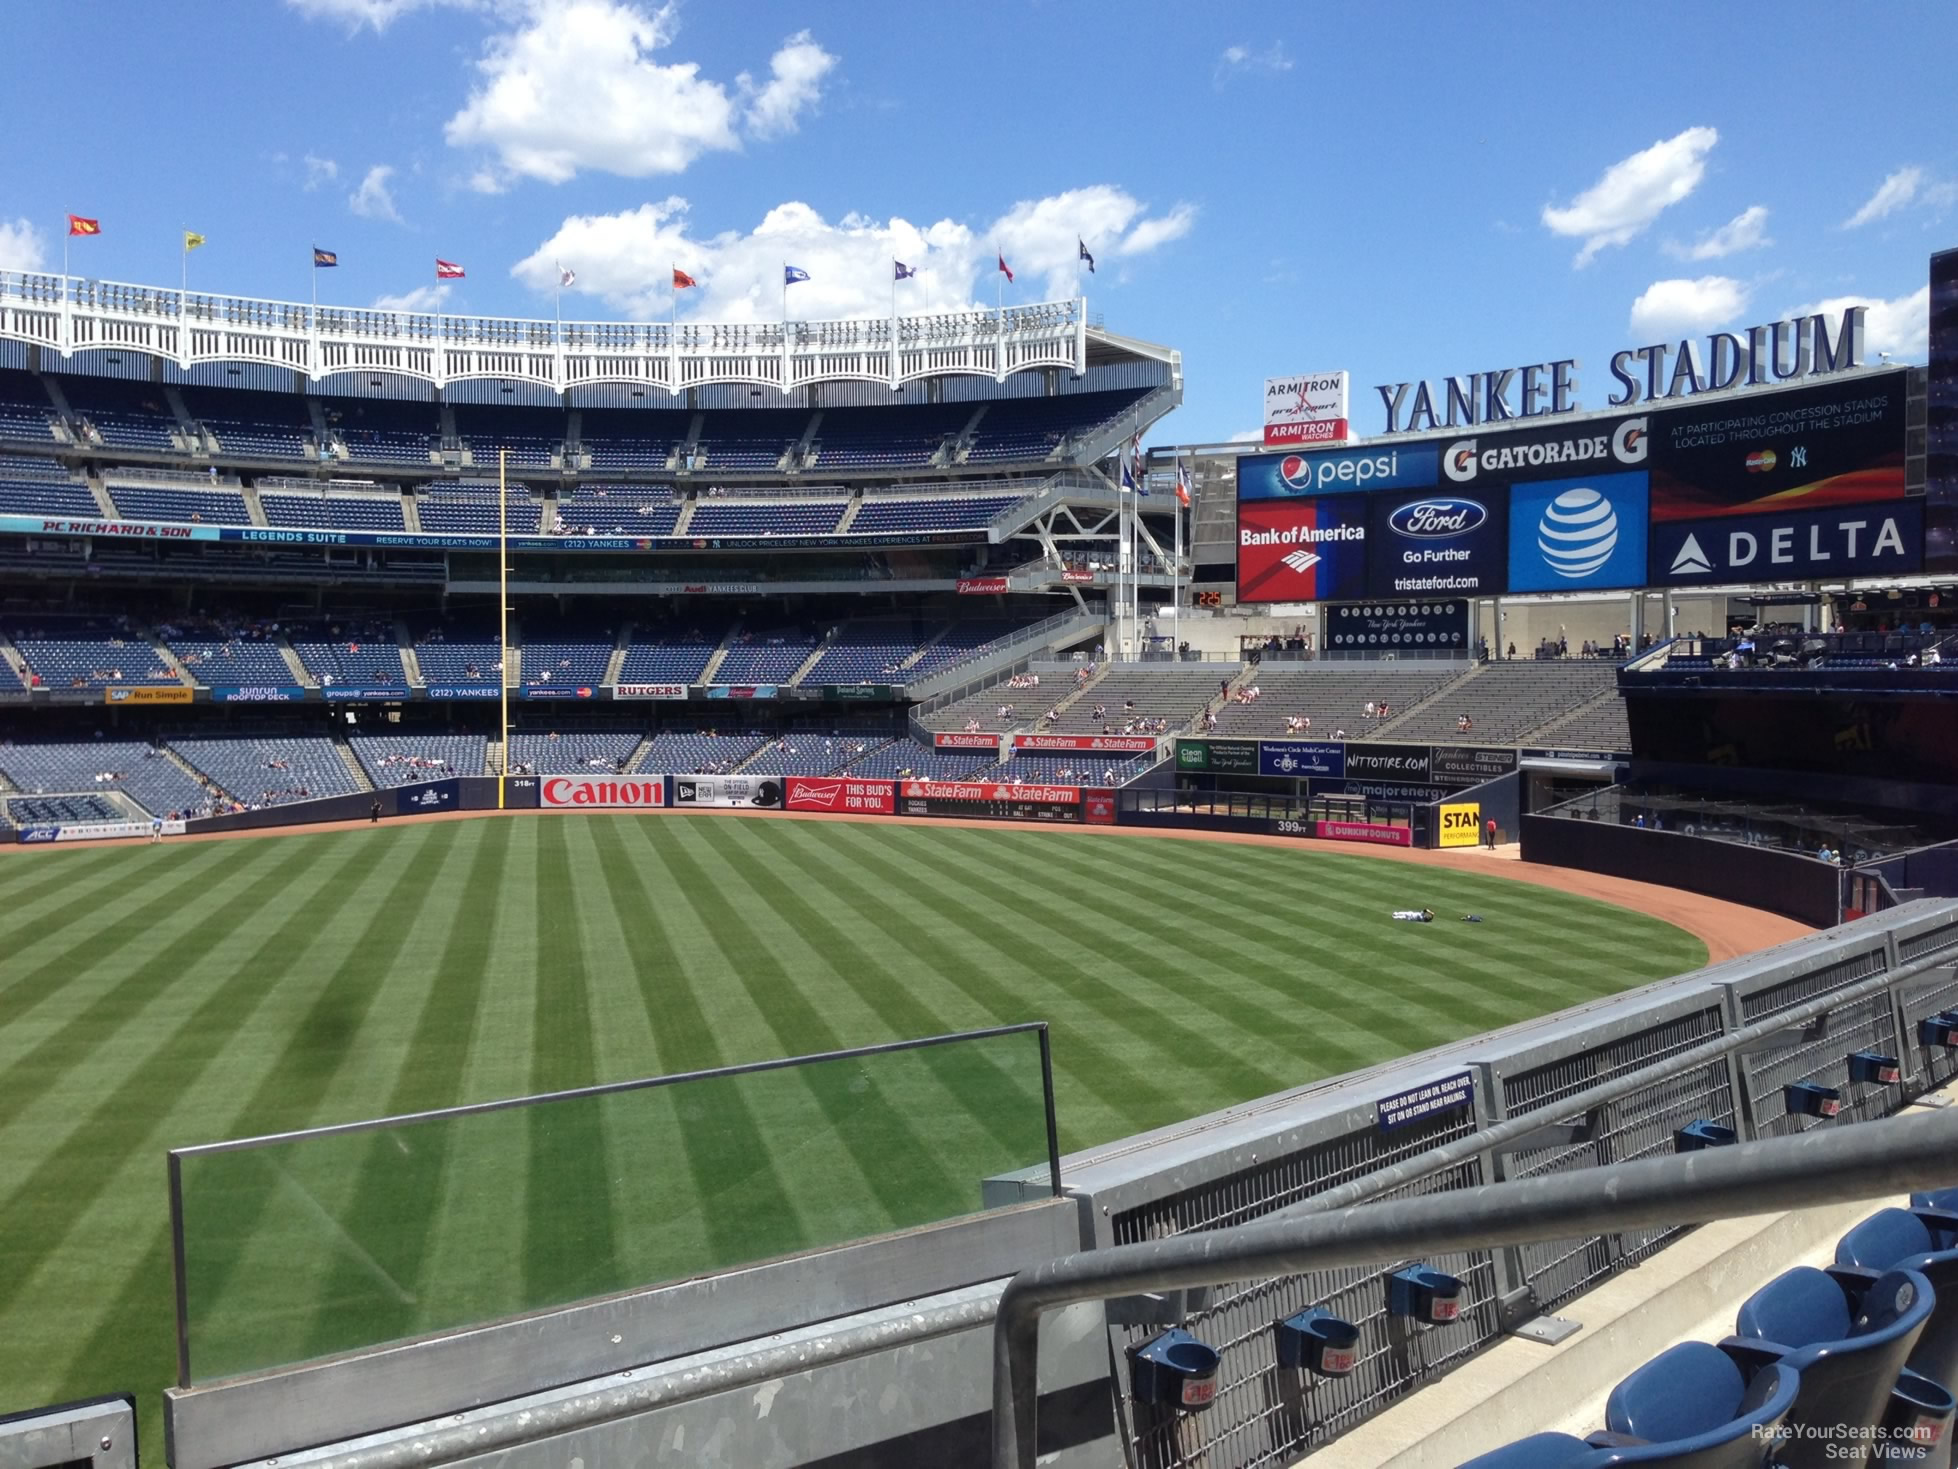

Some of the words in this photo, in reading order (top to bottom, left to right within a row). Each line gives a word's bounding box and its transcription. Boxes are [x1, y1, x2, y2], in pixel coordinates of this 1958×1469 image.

[1374, 358, 1581, 433] YANKEE
[1608, 306, 1868, 408] STADIUM
[1267, 378, 1340, 397] ARMITRON
[1671, 427, 1684, 437] AT
[1687, 414, 1766, 434] PARTICIPATING
[1769, 404, 1841, 424] CONCESSION
[1844, 396, 1888, 413] STANDS
[1270, 422, 1336, 438] ARMITRON
[1301, 431, 1334, 441] WATCHES
[1675, 433, 1725, 449] LOCATED
[1729, 422, 1806, 441] THROUGHOUT
[1809, 418, 1830, 430] THE
[1833, 410, 1882, 427] STADIUM
[1481, 436, 1608, 470] GATORADE
[1317, 451, 1398, 489] pepsi
[1407, 504, 1466, 532] Ford
[68, 522, 145, 536] RICHARD
[146, 526, 158, 536] &
[160, 527, 192, 538] SON
[1241, 527, 1280, 545] Bank
[1281, 526, 1298, 543] of
[1299, 523, 1364, 543] America
[242, 531, 303, 542] LEGENDS
[308, 533, 346, 544] SUITE
[376, 536, 414, 545] RESERVE
[417, 537, 440, 546] YOUR
[442, 538, 467, 546] SEATS
[469, 539, 492, 547] NOW!
[564, 539, 586, 549] (212)
[588, 540, 630, 548] YANKEES
[800, 539, 815, 547] NEW
[840, 538, 872, 546] YANKEES
[873, 536, 921, 545] EXPERIENCES
[1729, 517, 1905, 568] DELTA
[1403, 551, 1421, 563] Go
[1424, 549, 1471, 562] Further
[684, 585, 707, 593] Audi
[709, 585, 738, 593] YANKEES
[740, 585, 757, 593] CLUB
[959, 581, 1006, 593] Budweiser
[1395, 576, 1478, 590] tristateford.com
[111, 690, 129, 699] SAP
[134, 691, 153, 699] Run
[155, 690, 187, 700] Simple
[227, 693, 266, 701] ROOFTOP
[268, 693, 290, 701] DECK
[430, 689, 454, 698] (212)
[456, 689, 499, 697] YANKEES
[529, 689, 571, 697] yankees.com
[617, 686, 683, 696] RUTGERS
[1181, 748, 1202, 756] Clean
[1476, 753, 1512, 763] STEINER
[1347, 753, 1429, 772] NITTOTIRE.COM
[1445, 763, 1502, 773] COLLECTIBLES
[543, 778, 662, 805] Canon
[793, 787, 836, 799] Budweiser
[845, 784, 865, 795] THIS
[866, 784, 893, 796] BUD'S
[845, 797, 863, 807] FOR
[864, 797, 884, 808] YOU.
[24, 829, 53, 841] ACC
[1335, 826, 1369, 838] DUNKIN'
[1369, 829, 1400, 841] DONUTS
[1380, 1100, 1399, 1113] PLEASE
[1400, 1097, 1407, 1106] DO
[1408, 1093, 1418, 1104] NOT
[1419, 1089, 1431, 1100] LEAN
[1441, 1081, 1456, 1093] REACH
[1388, 1113, 1396, 1124] SIT
[1397, 1110, 1405, 1121] ON
[1405, 1107, 1413, 1118] OR
[1413, 1102, 1430, 1115] STAND
[1430, 1098, 1444, 1109] NEAR
